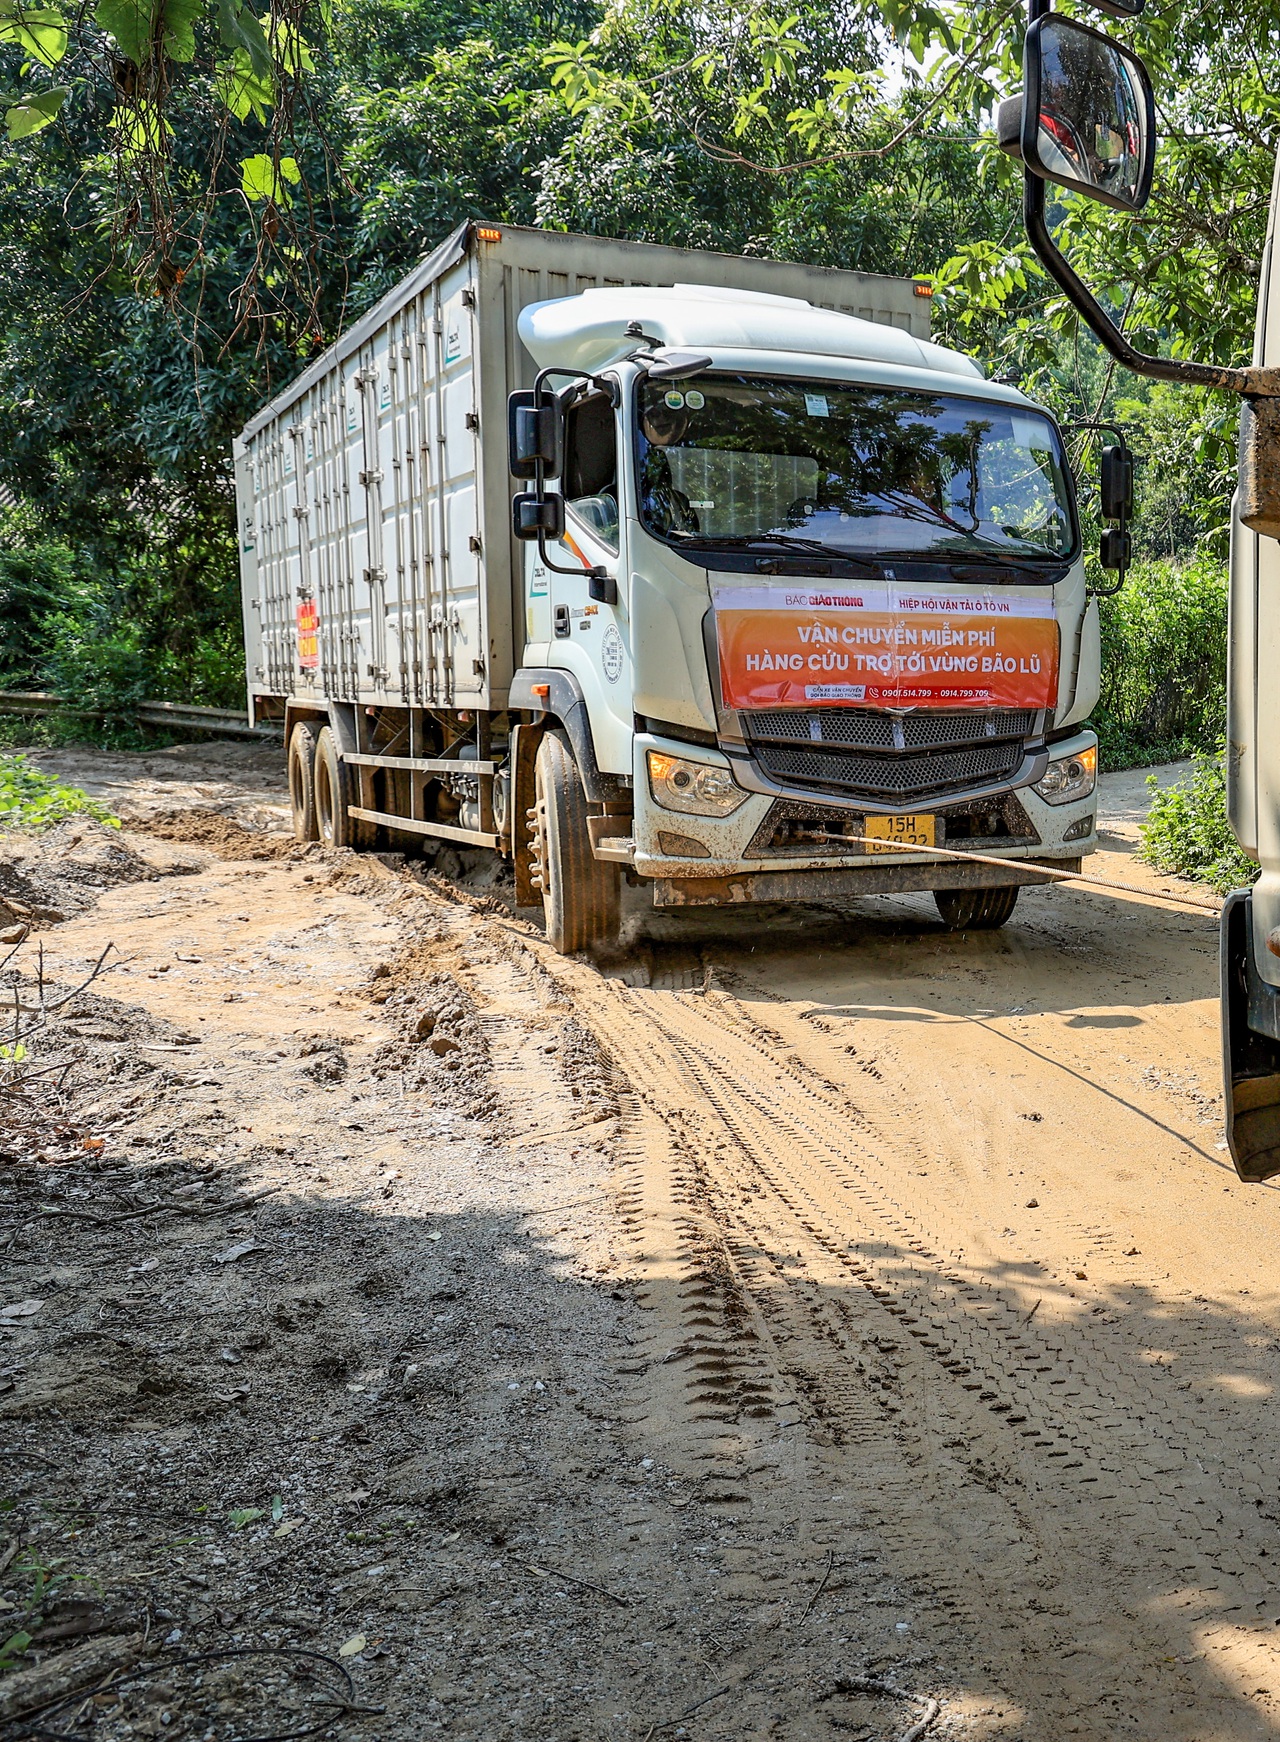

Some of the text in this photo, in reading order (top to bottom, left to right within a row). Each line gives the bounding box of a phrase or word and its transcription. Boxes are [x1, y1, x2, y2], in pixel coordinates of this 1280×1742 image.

[899, 598, 1010, 613] HIỆP HỘI VẬN TẢI Ô TÔ VN
[797, 620, 997, 648] VẬN CHUYỂN MIỄN PHÍ
[746, 649, 1041, 676] HÀNG CỨU TRỢ TỚI VÙNG BÃO LŨ
[882, 689, 932, 698] 0901.514.799
[940, 689, 989, 698] 0914.799.709
[887, 816, 916, 833] 15H
